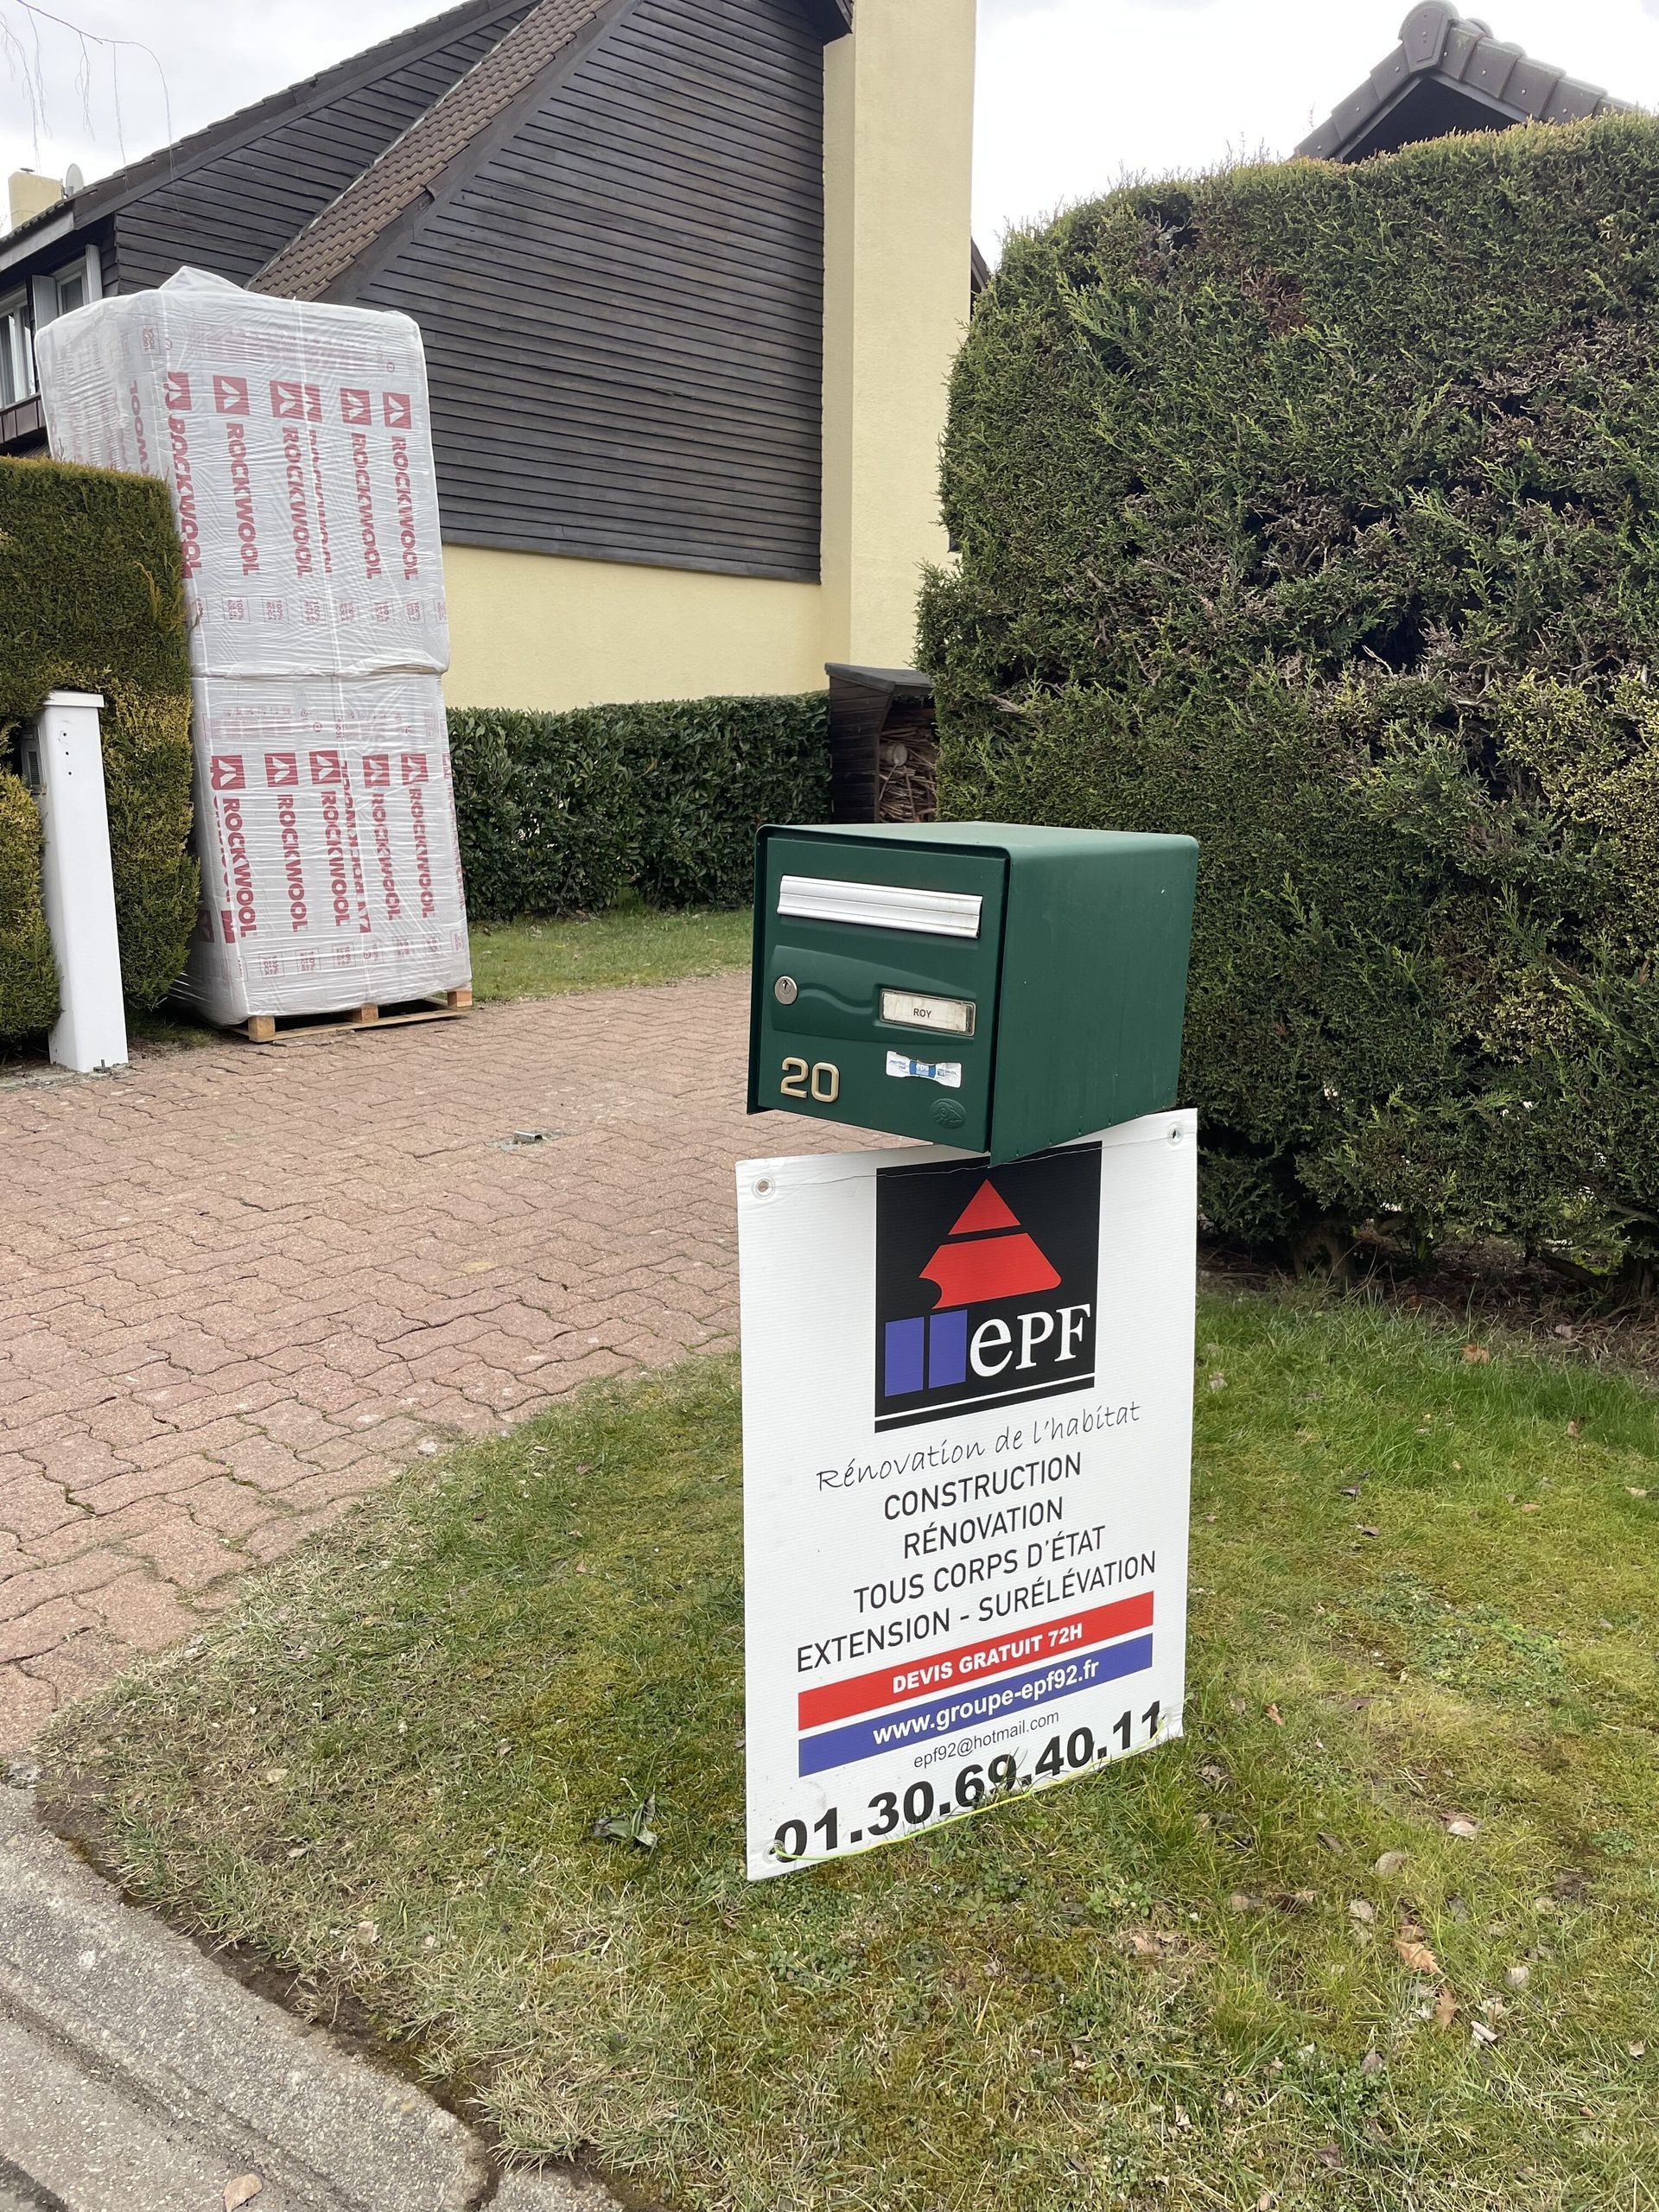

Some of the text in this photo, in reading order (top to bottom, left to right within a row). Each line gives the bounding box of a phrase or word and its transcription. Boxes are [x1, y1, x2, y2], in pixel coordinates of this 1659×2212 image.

[226, 423, 260, 576] ROCKWOOL
[283, 427, 313, 578] ROCKWOOL
[352, 433, 383, 580] ROCKWOOL
[391, 435, 420, 581] ROCKWOOL
[223, 798, 255, 938] ROCKWOOL
[277, 794, 308, 932] ROCKWOOL
[321, 791, 350, 926] ROCKWOOL
[371, 793, 401, 920] ROCKWOOL
[408, 788, 434, 918] ROCKWOOL
[913, 1007, 932, 1019] ROY
[780, 1056, 839, 1103] 20
[969, 1303, 1090, 1377] ePF
[817, 1401, 1141, 1492] Rénovation de l'habitat
[884, 1452, 1082, 1521] CONSTRUCTION
[854, 1525, 1106, 1614] TOUS CORPS D'ÉTAT
[903, 1497, 1064, 1560] RÉNOVATION
[798, 1607, 950, 1673] EXTENSION
[978, 1550, 1156, 1622] SURÉLÉVATION
[893, 1623, 1084, 1694] DEVIS GRATUIT 72H
[873, 1656, 1100, 1745] www.groupe-epf92.fr
[913, 1710, 1059, 1770] epf92@hotmail.com
[774, 1699, 1163, 1865] 01.30.69.40.11
